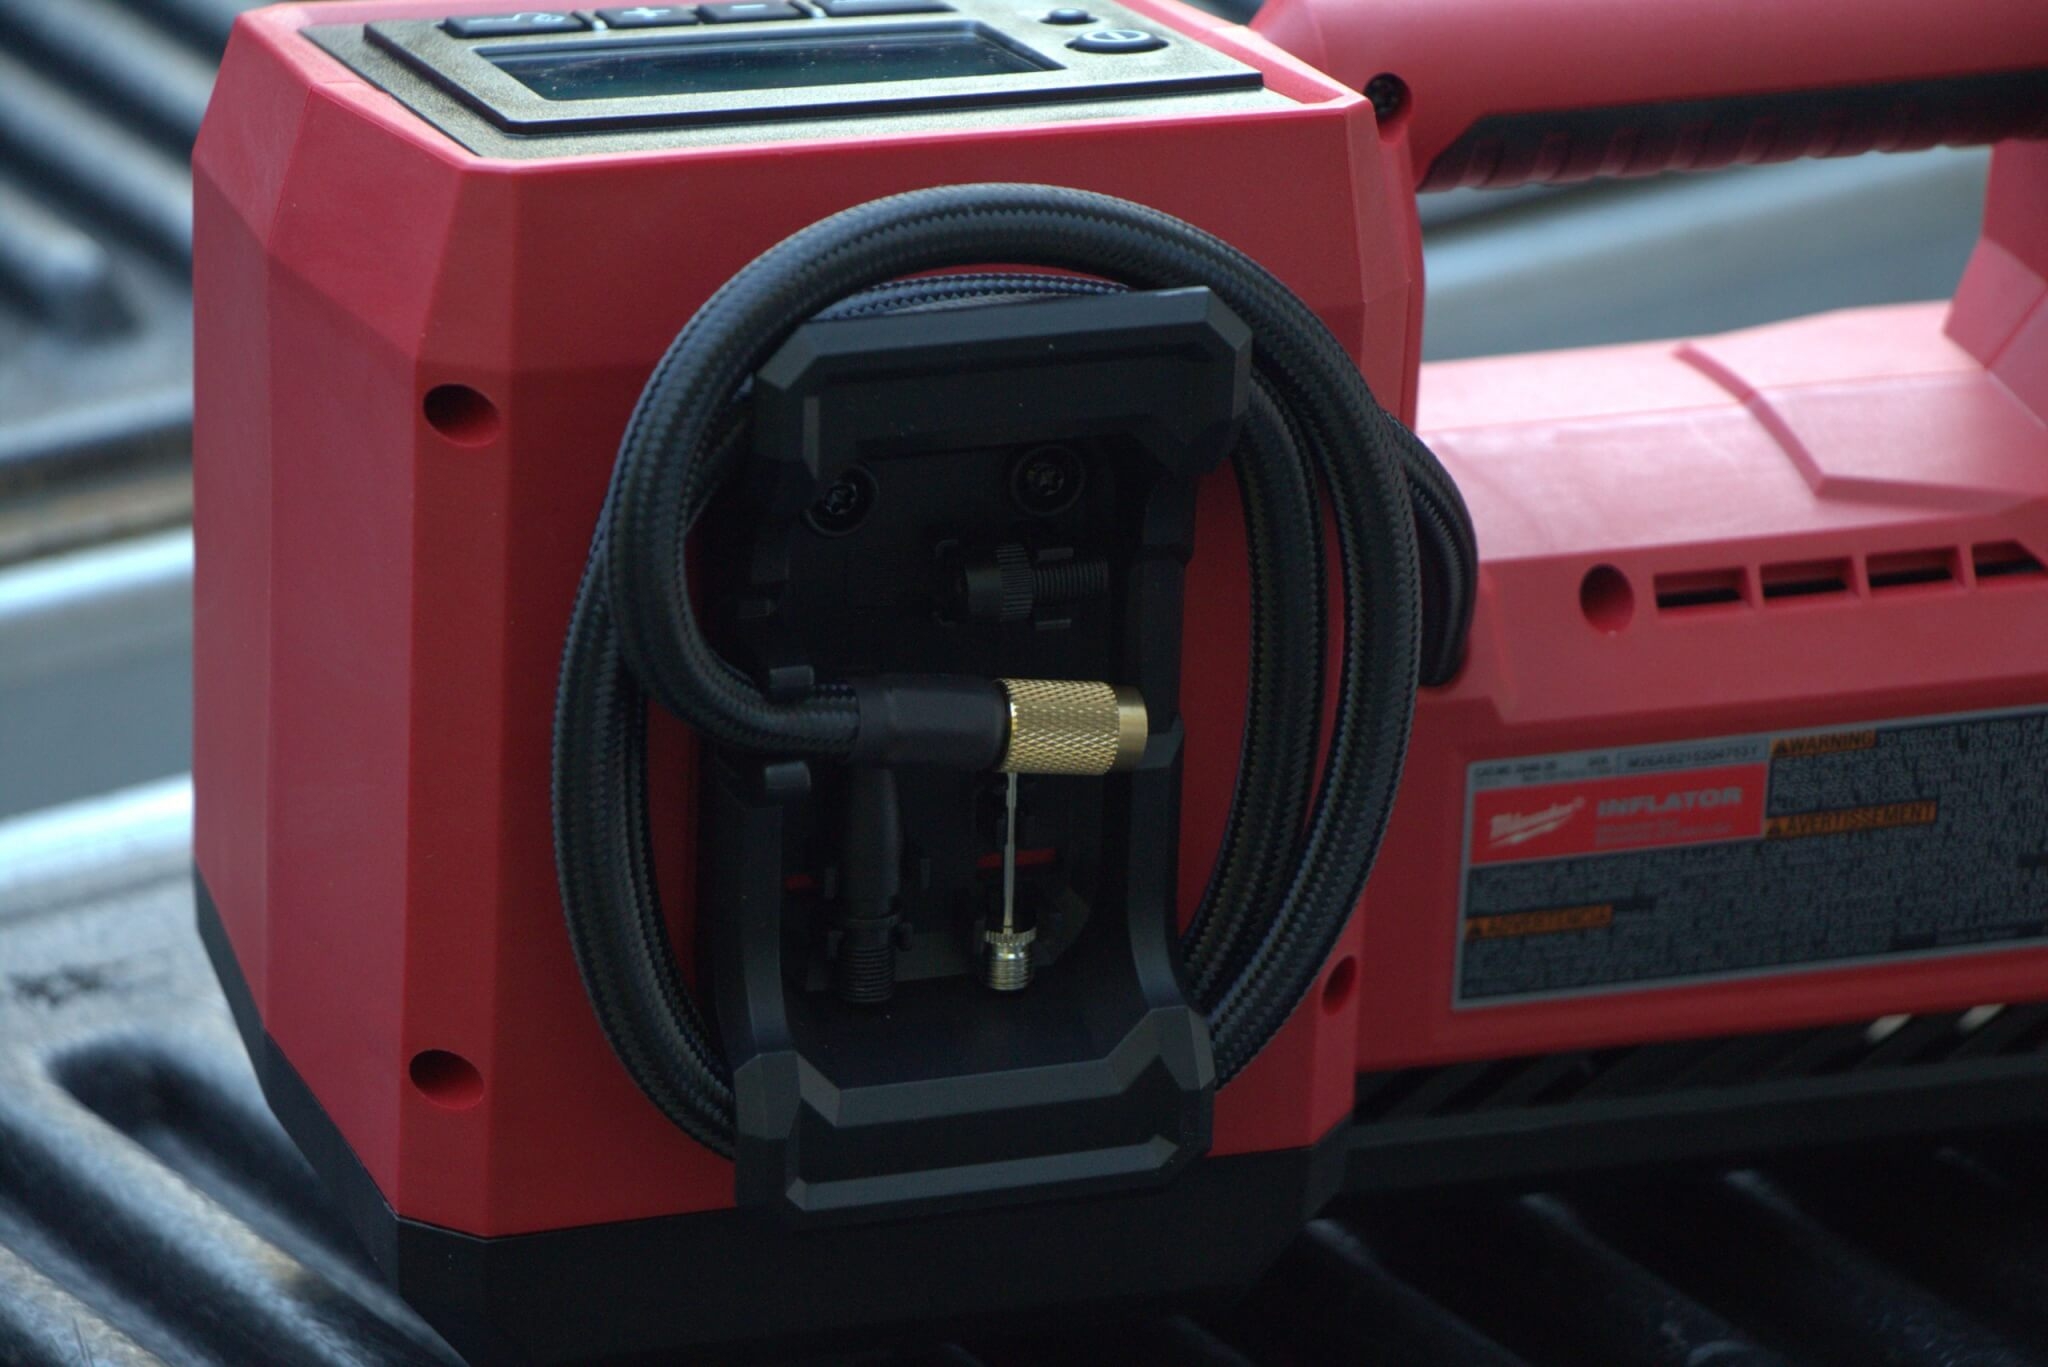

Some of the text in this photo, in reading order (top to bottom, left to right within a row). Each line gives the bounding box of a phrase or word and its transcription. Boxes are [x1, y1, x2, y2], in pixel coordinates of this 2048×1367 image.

[1790, 731, 1873, 750] WARNING
[1879, 732, 1897, 745] TO
[1960, 723, 1987, 737] THE
[1597, 787, 1743, 817] INFLATOR
[1789, 803, 1934, 835] AVERTISSEMENT
